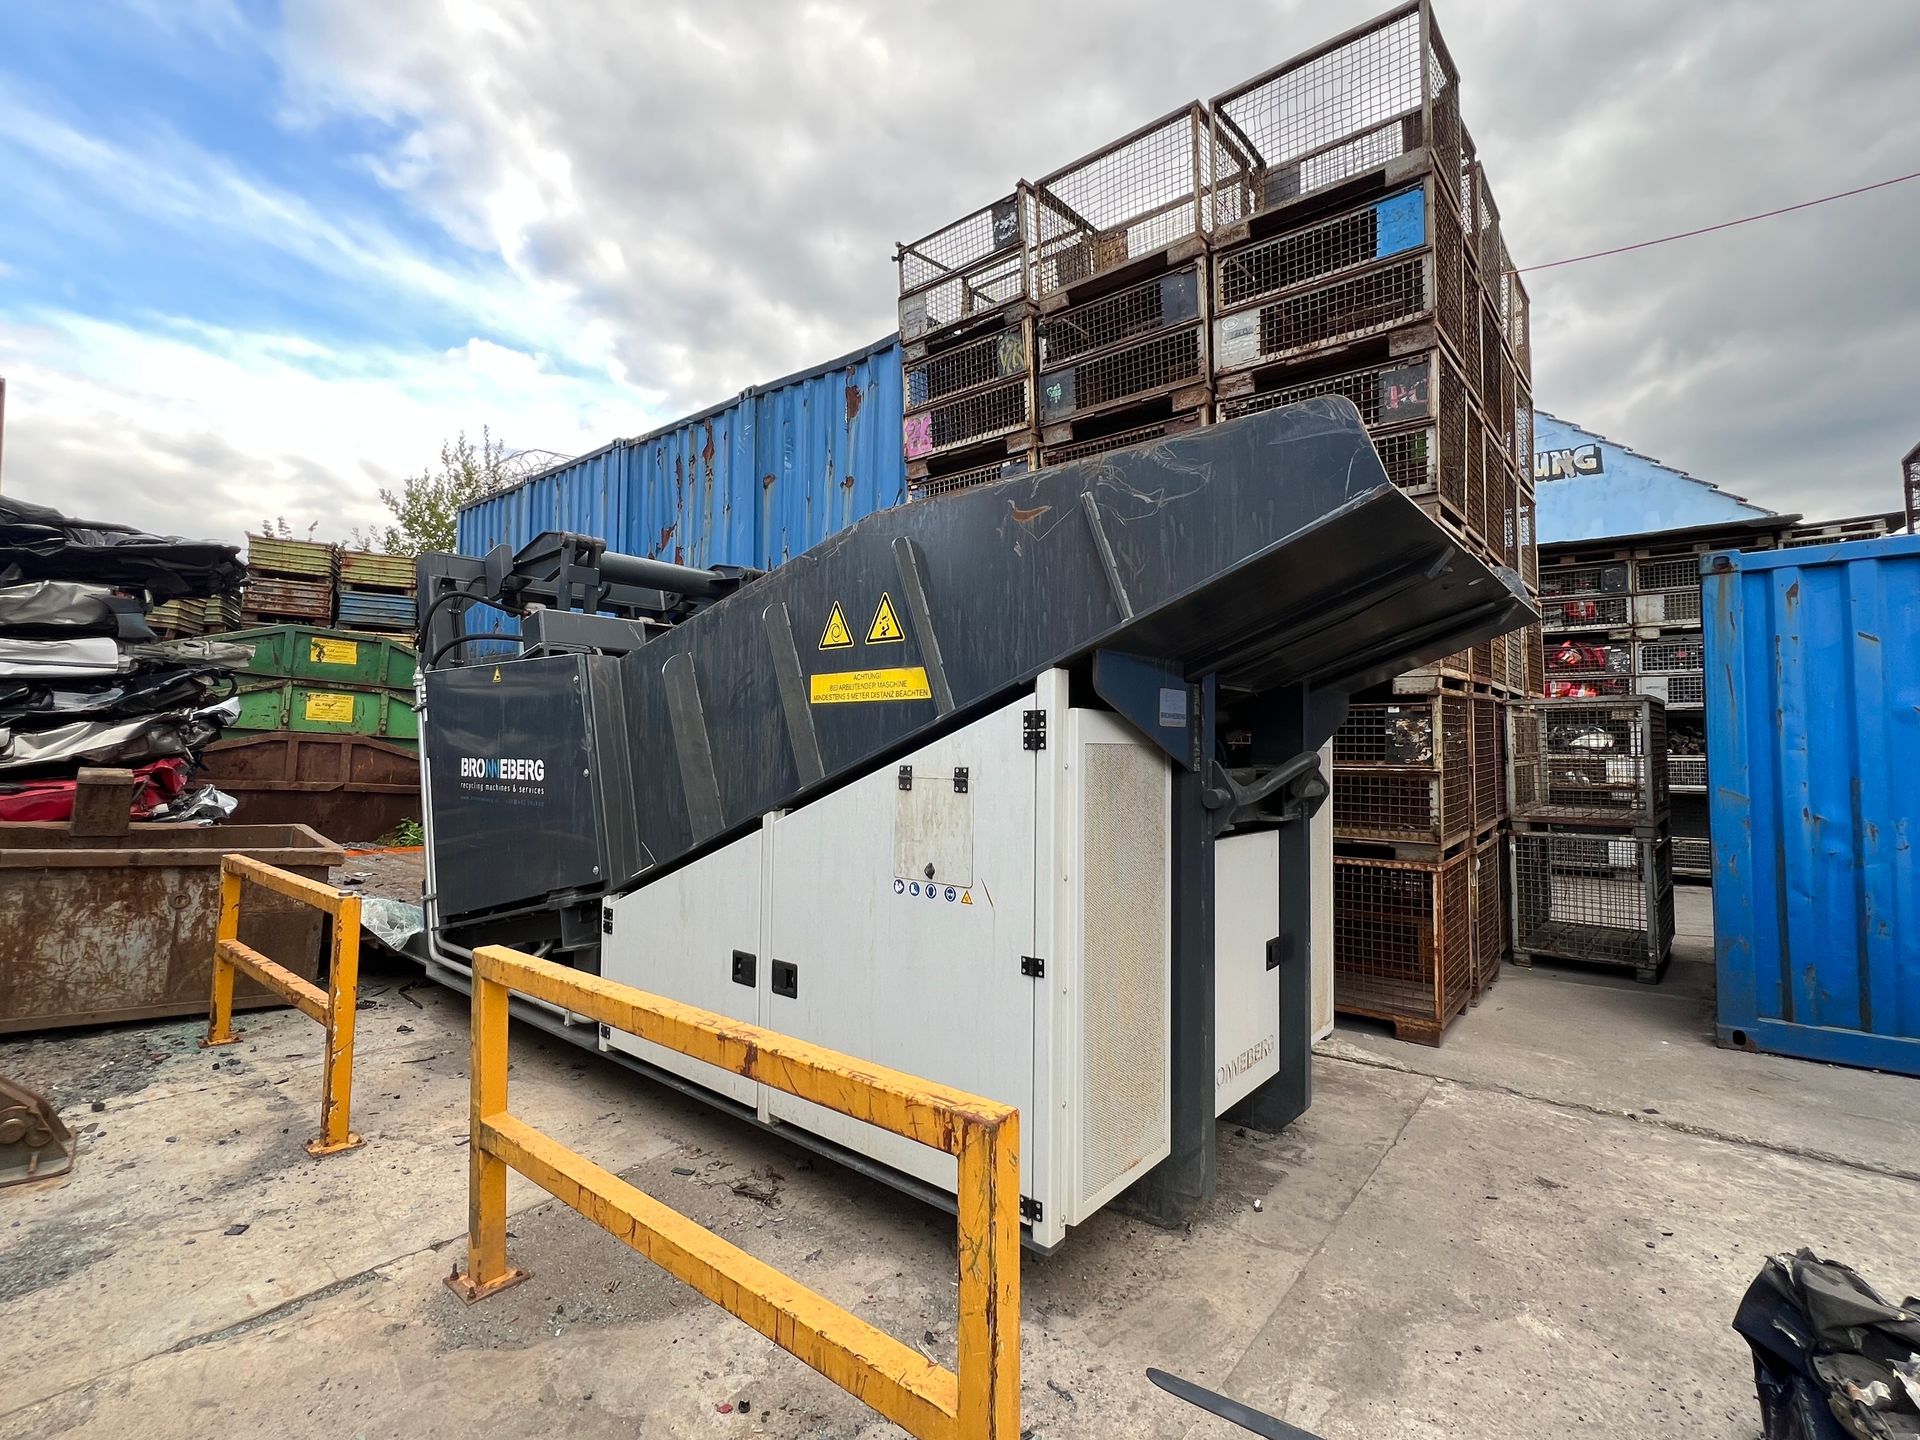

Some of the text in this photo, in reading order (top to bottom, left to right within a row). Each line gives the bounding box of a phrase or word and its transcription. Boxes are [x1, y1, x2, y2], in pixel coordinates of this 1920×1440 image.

[1535, 444, 1602, 480] UNG
[853, 672, 881, 681] ACHTUNG!
[830, 680, 907, 692] BEI ARBEITENDER MASCHINE
[813, 693, 846, 701] MINDESTENS
[851, 692, 870, 700] METER
[871, 690, 894, 699] DISTANZ
[896, 689, 928, 698] BEACHTEN
[460, 757, 545, 782] BRONNEBERG
[460, 781, 545, 795] recycling machines & services
[1215, 1033, 1275, 1088] ONNEBERG
